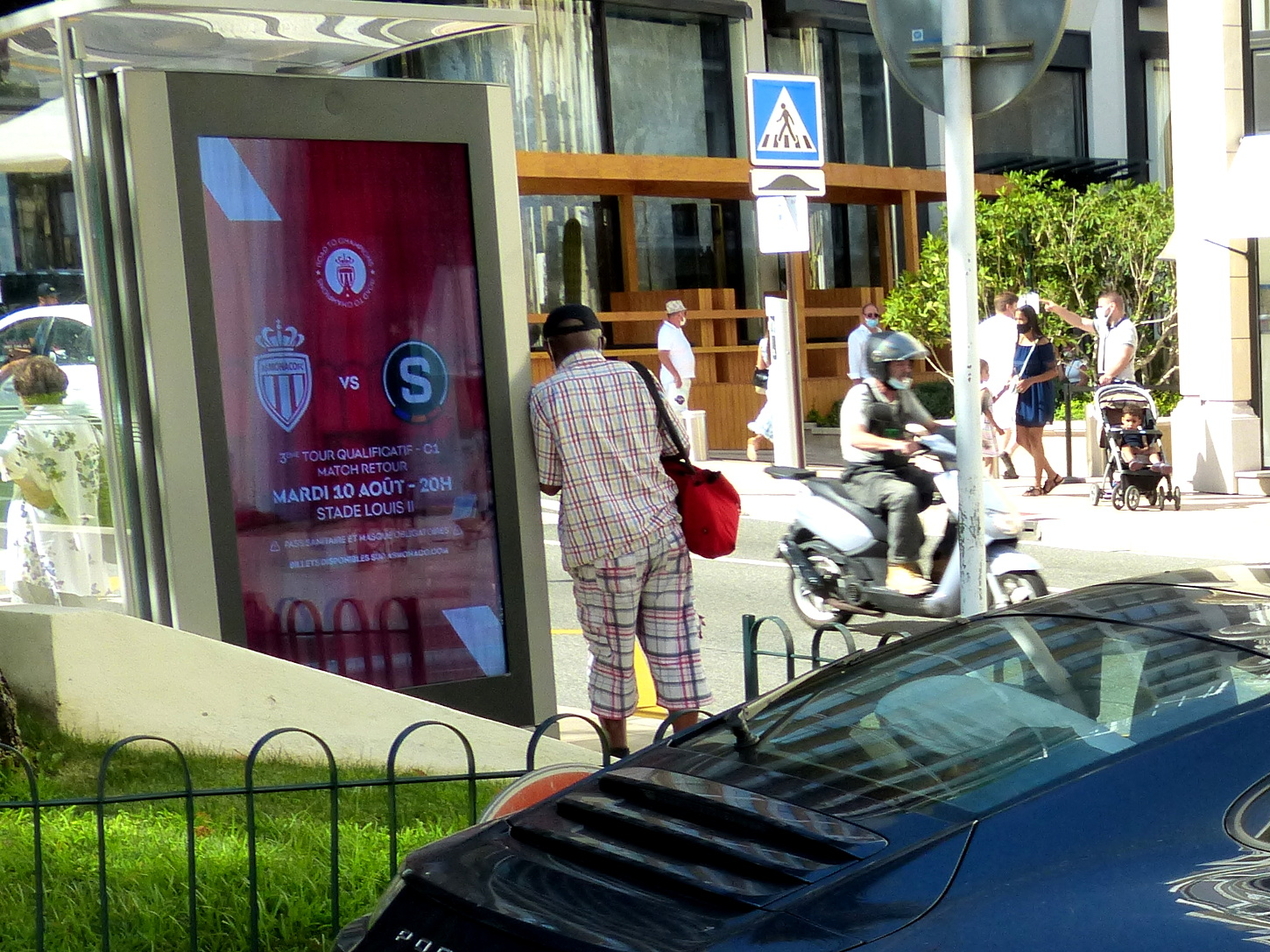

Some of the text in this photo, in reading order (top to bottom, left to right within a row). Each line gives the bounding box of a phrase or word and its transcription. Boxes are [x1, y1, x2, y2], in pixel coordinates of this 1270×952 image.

[400, 356, 432, 404] S
[302, 450, 335, 462] TOUR
[337, 444, 413, 460] QUALIFICATIF
[423, 443, 440, 454] C1
[317, 461, 408, 477] MATCH RETOUR
[273, 485, 329, 504] MARDI
[333, 482, 355, 499] 10
[358, 477, 405, 498] AOÛT
[419, 476, 452, 493] 20H
[316, 500, 414, 520] STADE LOUIS II
[285, 540, 306, 548] PASS
[306, 537, 346, 547] SANITAIRE
[347, 535, 357, 544] ET
[359, 530, 393, 542] MASQUE
[289, 559, 320, 569] BILLETS
